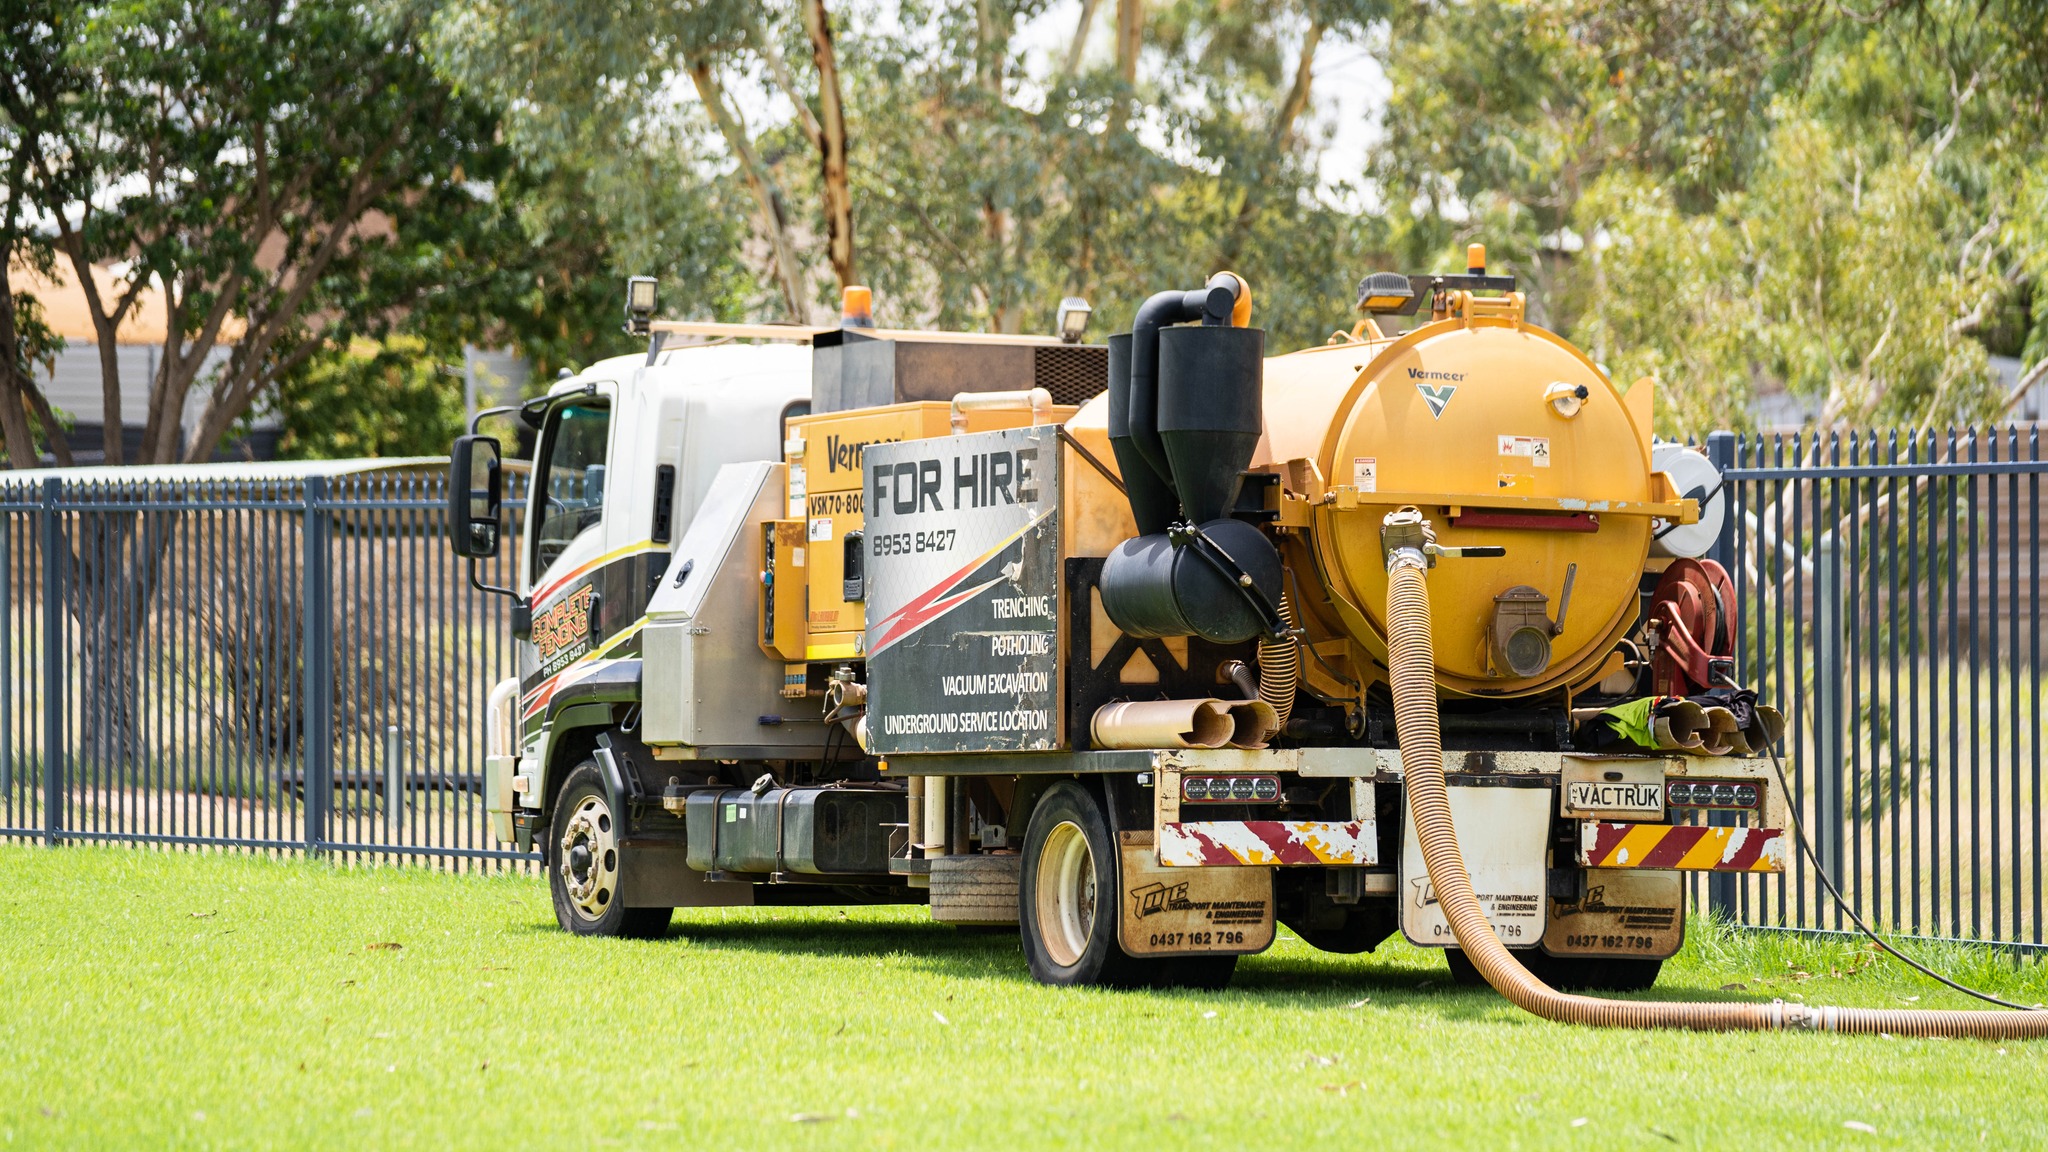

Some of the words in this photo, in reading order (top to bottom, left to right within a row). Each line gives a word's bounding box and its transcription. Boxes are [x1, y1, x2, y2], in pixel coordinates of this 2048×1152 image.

[1408, 368, 1464, 381] Vermeer
[873, 459, 944, 517] FOR
[954, 447, 1039, 510] HIRE
[873, 533, 911, 557] 8953
[915, 529, 956, 553] 8427
[532, 583, 593, 643] COMPLETE
[991, 596, 1048, 619] TRENCHING
[539, 610, 588, 662] FENCING
[991, 635, 1048, 656] POTHOLING
[543, 667, 552, 678] PH
[552, 655, 569, 671] 8953
[569, 642, 586, 661] 8427
[942, 674, 986, 696] VACUUM
[988, 672, 1048, 694] EXCAVATION
[884, 712, 958, 735] UNDERGROUND
[959, 711, 997, 733] SERVICE
[1000, 710, 1048, 732] LOCATION
[1578, 786, 1659, 807] VACTRUK
[1168, 902, 1211, 911] TRANSPORT
[1211, 901, 1265, 909] MAINTENANCE
[1495, 894, 1539, 902] MAINTENANCE
[1498, 903, 1538, 911] ENGINEERING
[1205, 911, 1212, 919] &
[1213, 910, 1264, 919] ENGINEERING
[1150, 933, 1184, 946] 0437
[1188, 932, 1212, 944] 162
[1216, 931, 1244, 944] 796
[1500, 924, 1522, 937] 796
[1567, 935, 1598, 947] 0437
[1602, 935, 1623, 948] 162
[1626, 936, 1653, 949] 796
